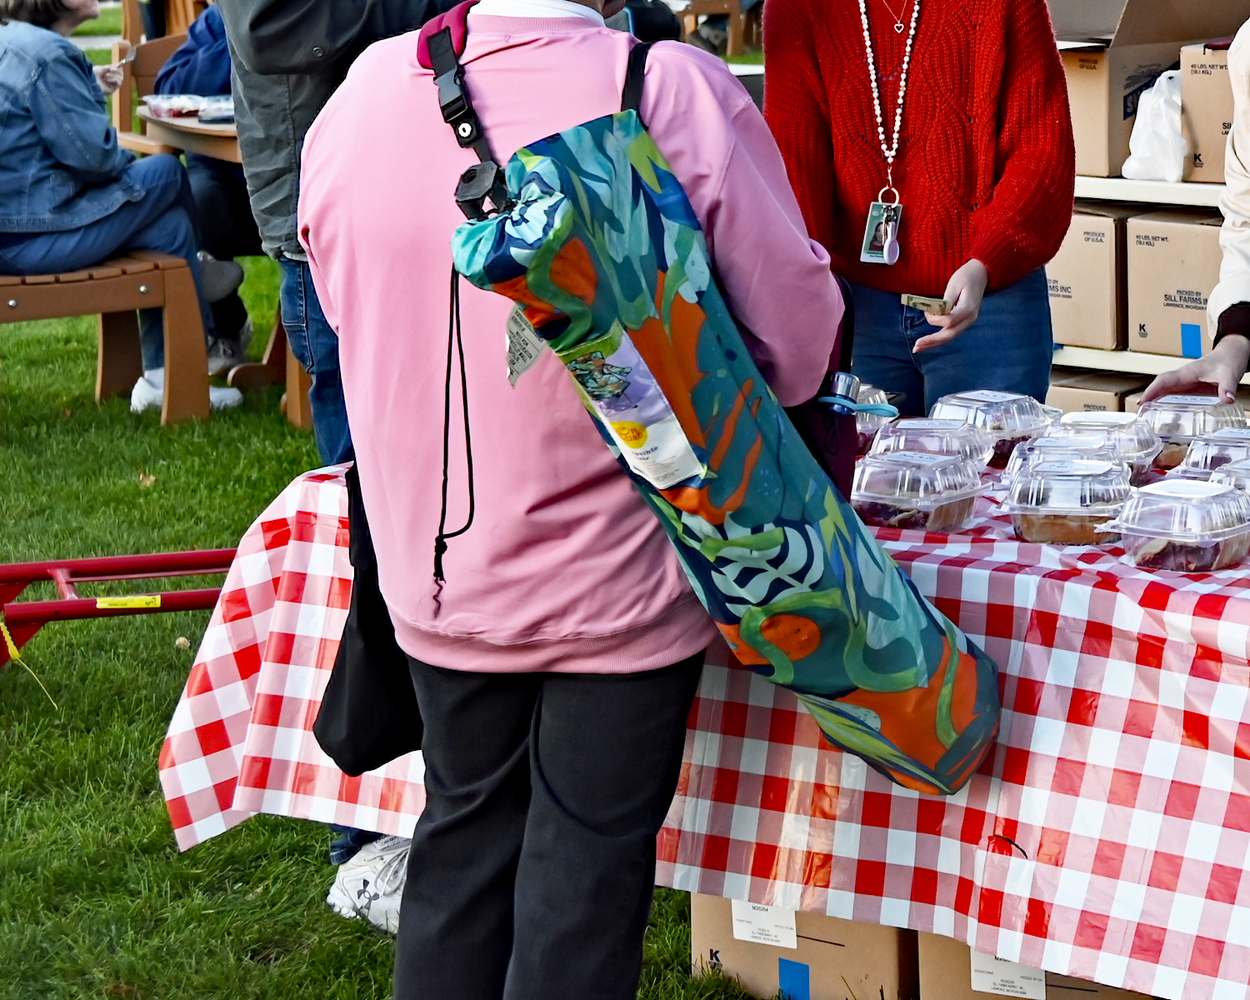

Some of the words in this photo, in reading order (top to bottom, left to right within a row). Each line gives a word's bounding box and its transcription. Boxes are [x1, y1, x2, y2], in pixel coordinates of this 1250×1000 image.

[1193, 153, 1202, 162] K
[1060, 286, 1072, 294] INC
[1164, 294, 1178, 303] SILL
[1179, 295, 1202, 305] FARMS
[1139, 323, 1146, 332] K
[709, 948, 720, 963] K
